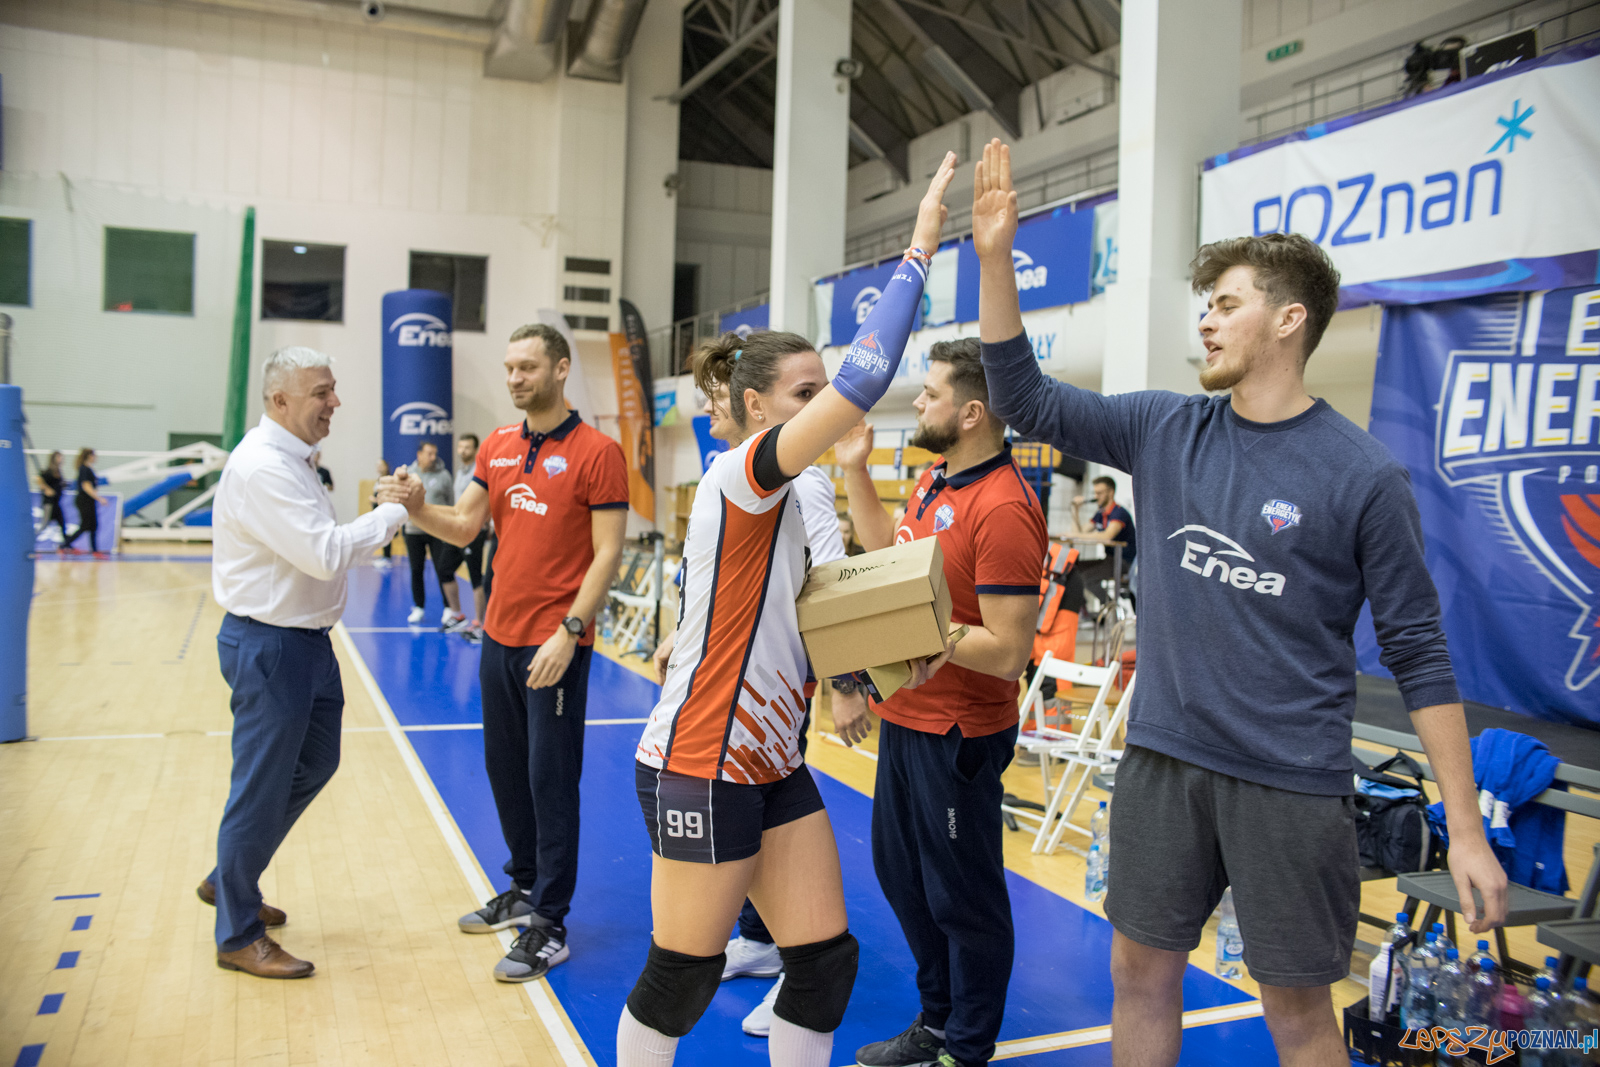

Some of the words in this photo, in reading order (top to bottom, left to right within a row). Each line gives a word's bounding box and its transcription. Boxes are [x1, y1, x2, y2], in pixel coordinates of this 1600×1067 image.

[398, 324, 453, 348] Ene
[399, 413, 453, 436] Ene
[510, 493, 548, 516] Enea
[1262, 504, 1301, 525] ENERGETYK
[1275, 502, 1292, 512] ENEA
[1180, 539, 1287, 597] Enea
[666, 809, 704, 839] 99
